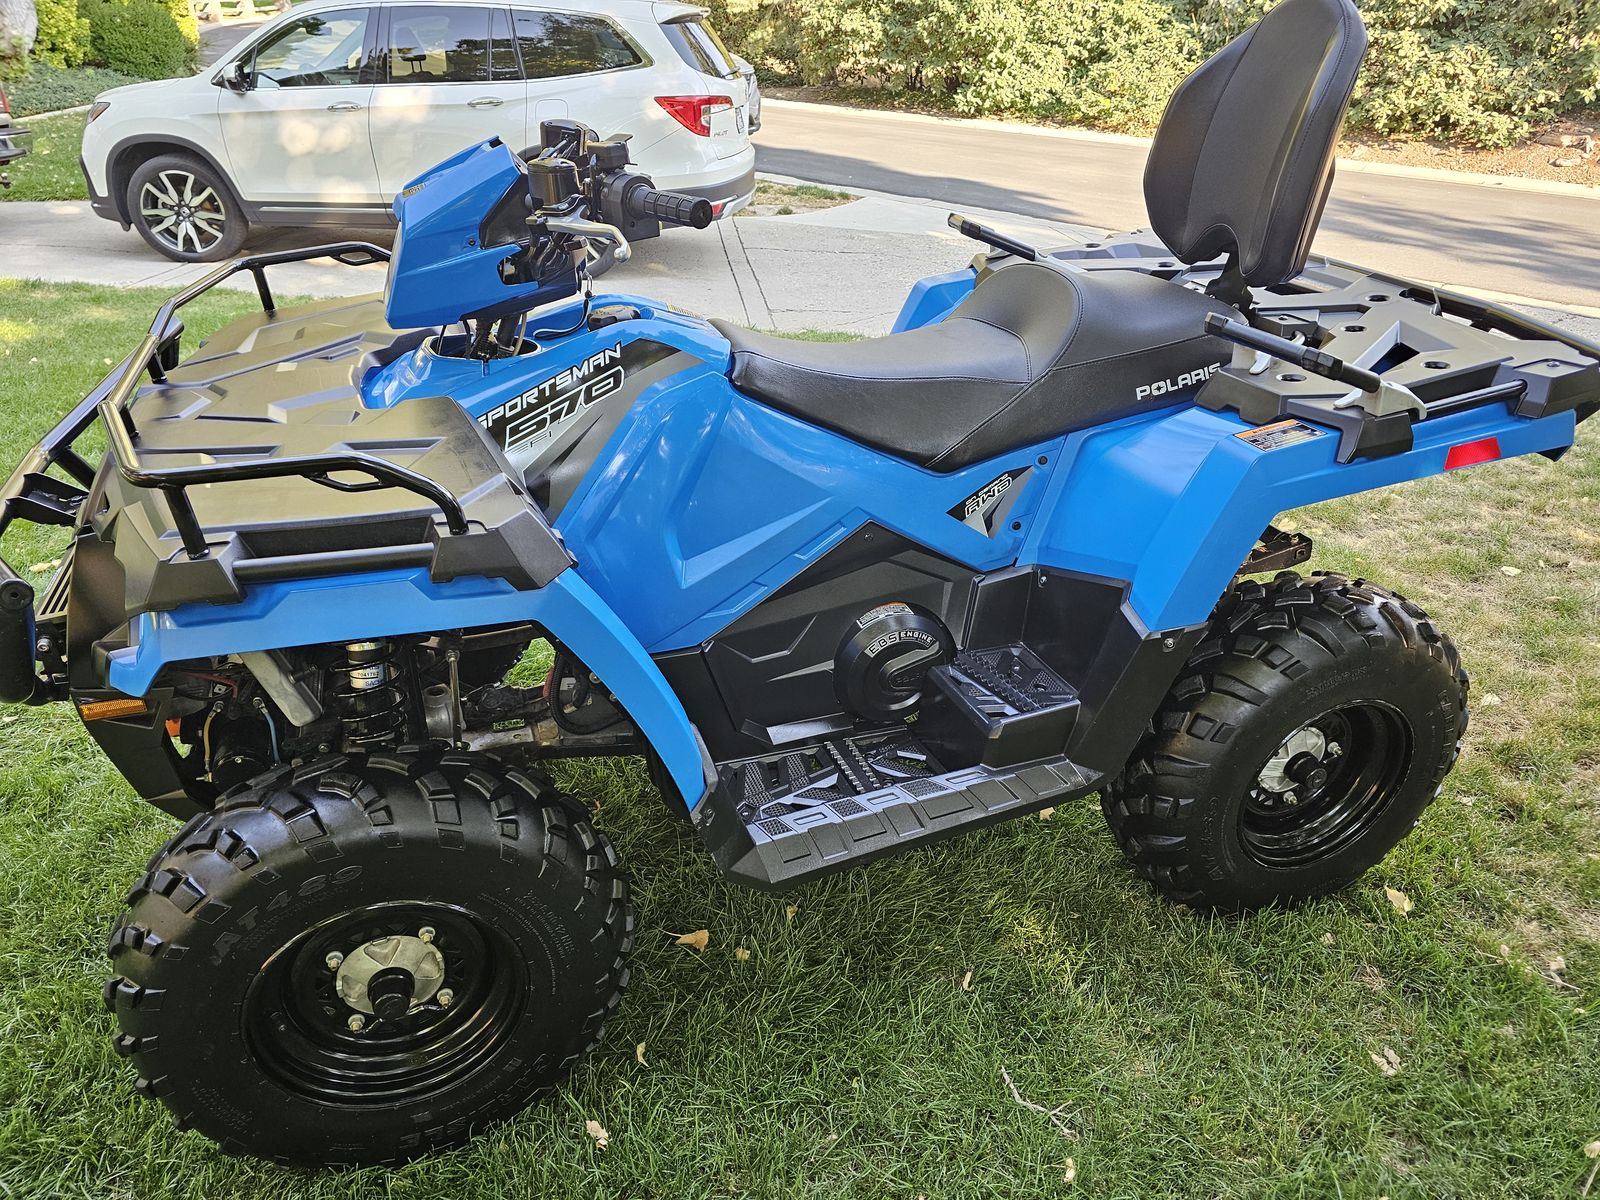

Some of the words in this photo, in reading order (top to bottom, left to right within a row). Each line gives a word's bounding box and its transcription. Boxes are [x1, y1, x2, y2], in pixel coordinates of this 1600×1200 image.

[477, 341, 622, 430] SPORTSMAN
[1135, 362, 1221, 400] POLARIS
[505, 366, 625, 451] 570
[964, 477, 1012, 518] AWD
[868, 632, 898, 654] EBS
[900, 631, 934, 643] ENGINE
